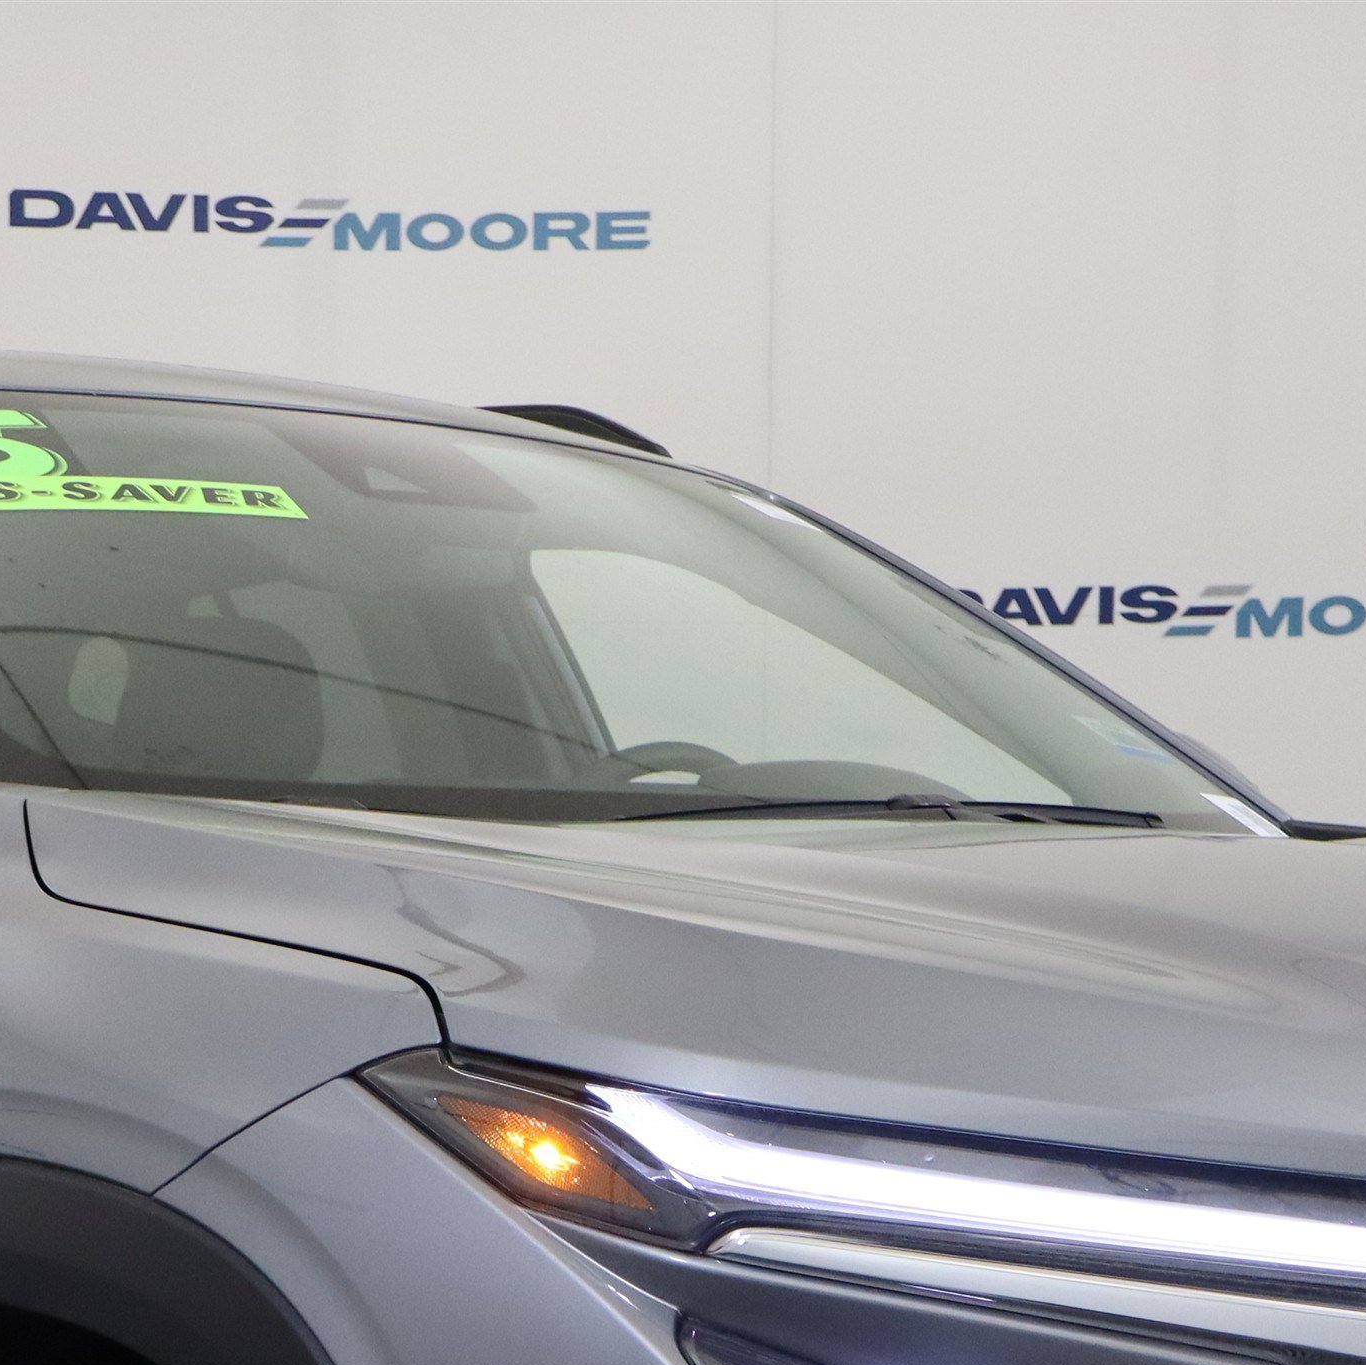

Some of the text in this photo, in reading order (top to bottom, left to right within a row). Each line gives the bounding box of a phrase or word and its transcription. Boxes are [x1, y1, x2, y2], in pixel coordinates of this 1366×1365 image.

[9, 188, 651, 251] DAVIS MOORE
[959, 584, 1179, 624] AVIS
